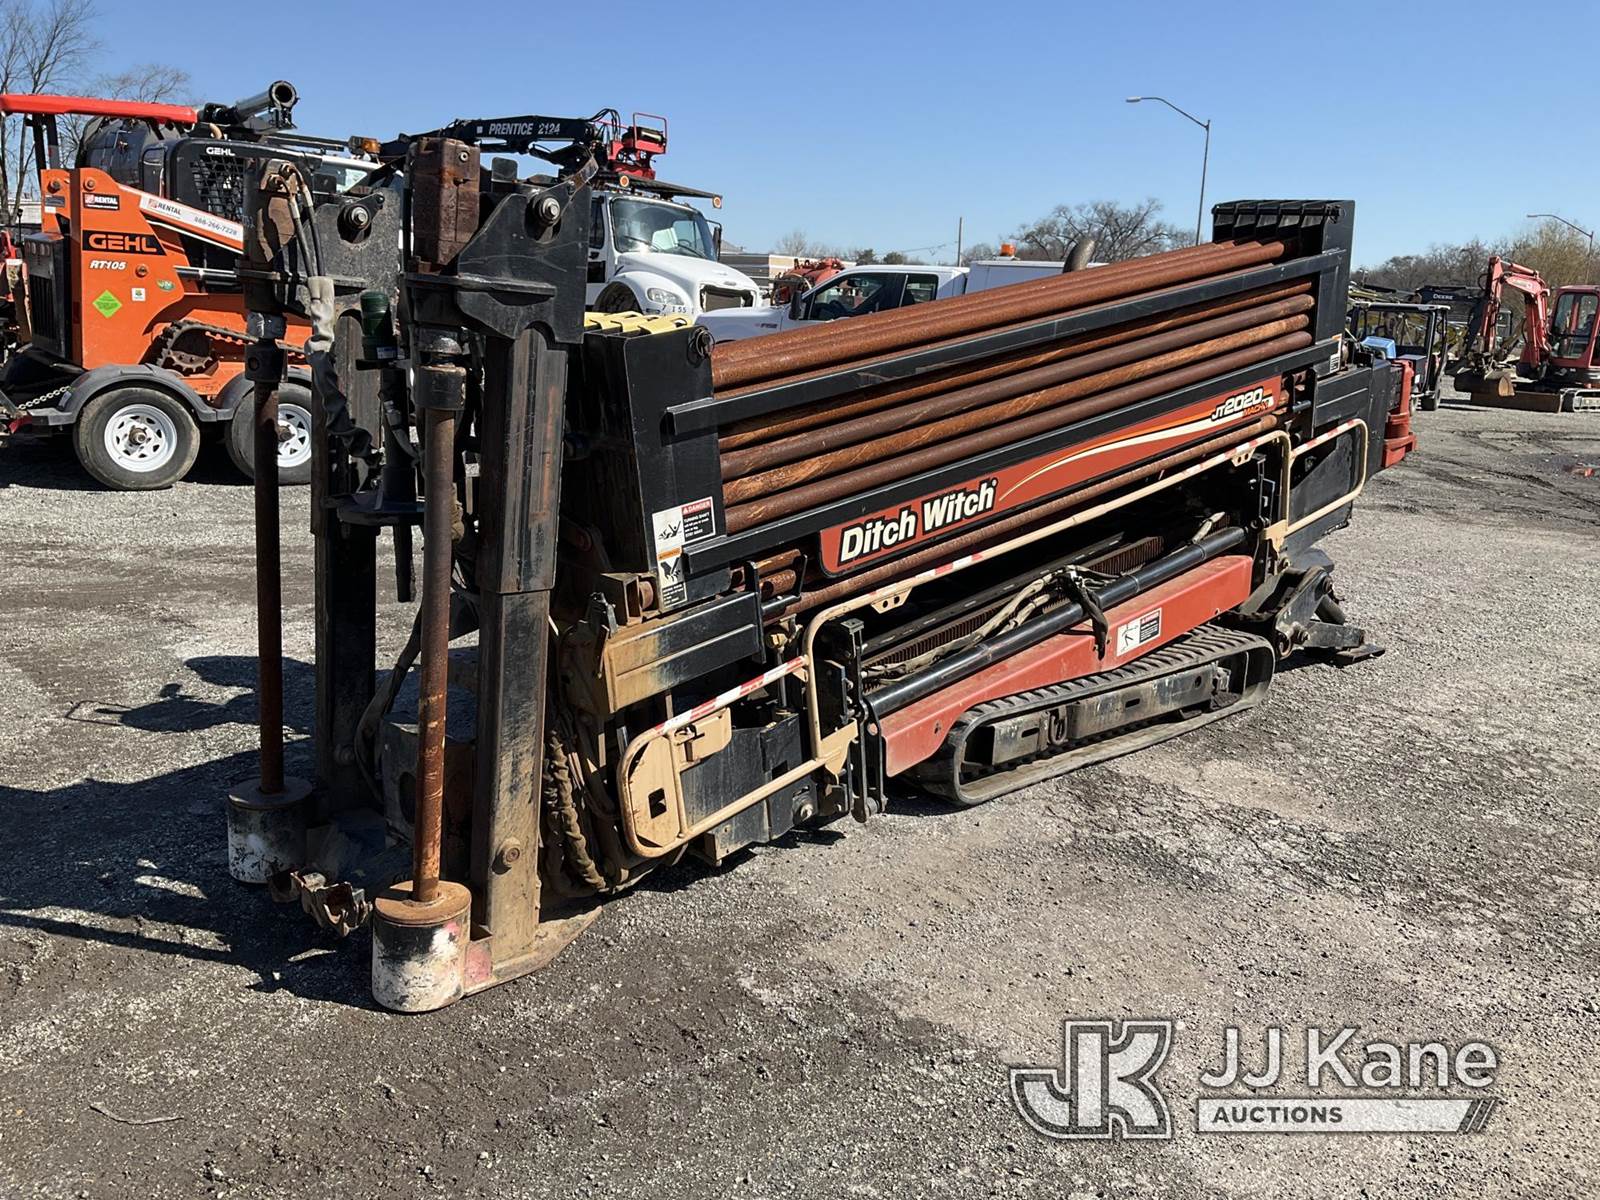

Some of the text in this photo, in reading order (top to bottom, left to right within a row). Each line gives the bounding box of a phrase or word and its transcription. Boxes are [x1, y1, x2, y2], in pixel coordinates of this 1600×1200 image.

[488, 122, 561, 136] PRENTICE 2124
[205, 146, 236, 157] GEHL
[94, 196, 118, 205] RENTAL
[157, 202, 182, 216] RENTAL
[88, 233, 157, 253] GEHL
[89, 259, 127, 270] RT105
[1210, 387, 1264, 420] JT2020
[840, 481, 995, 562] Ditch Witch
